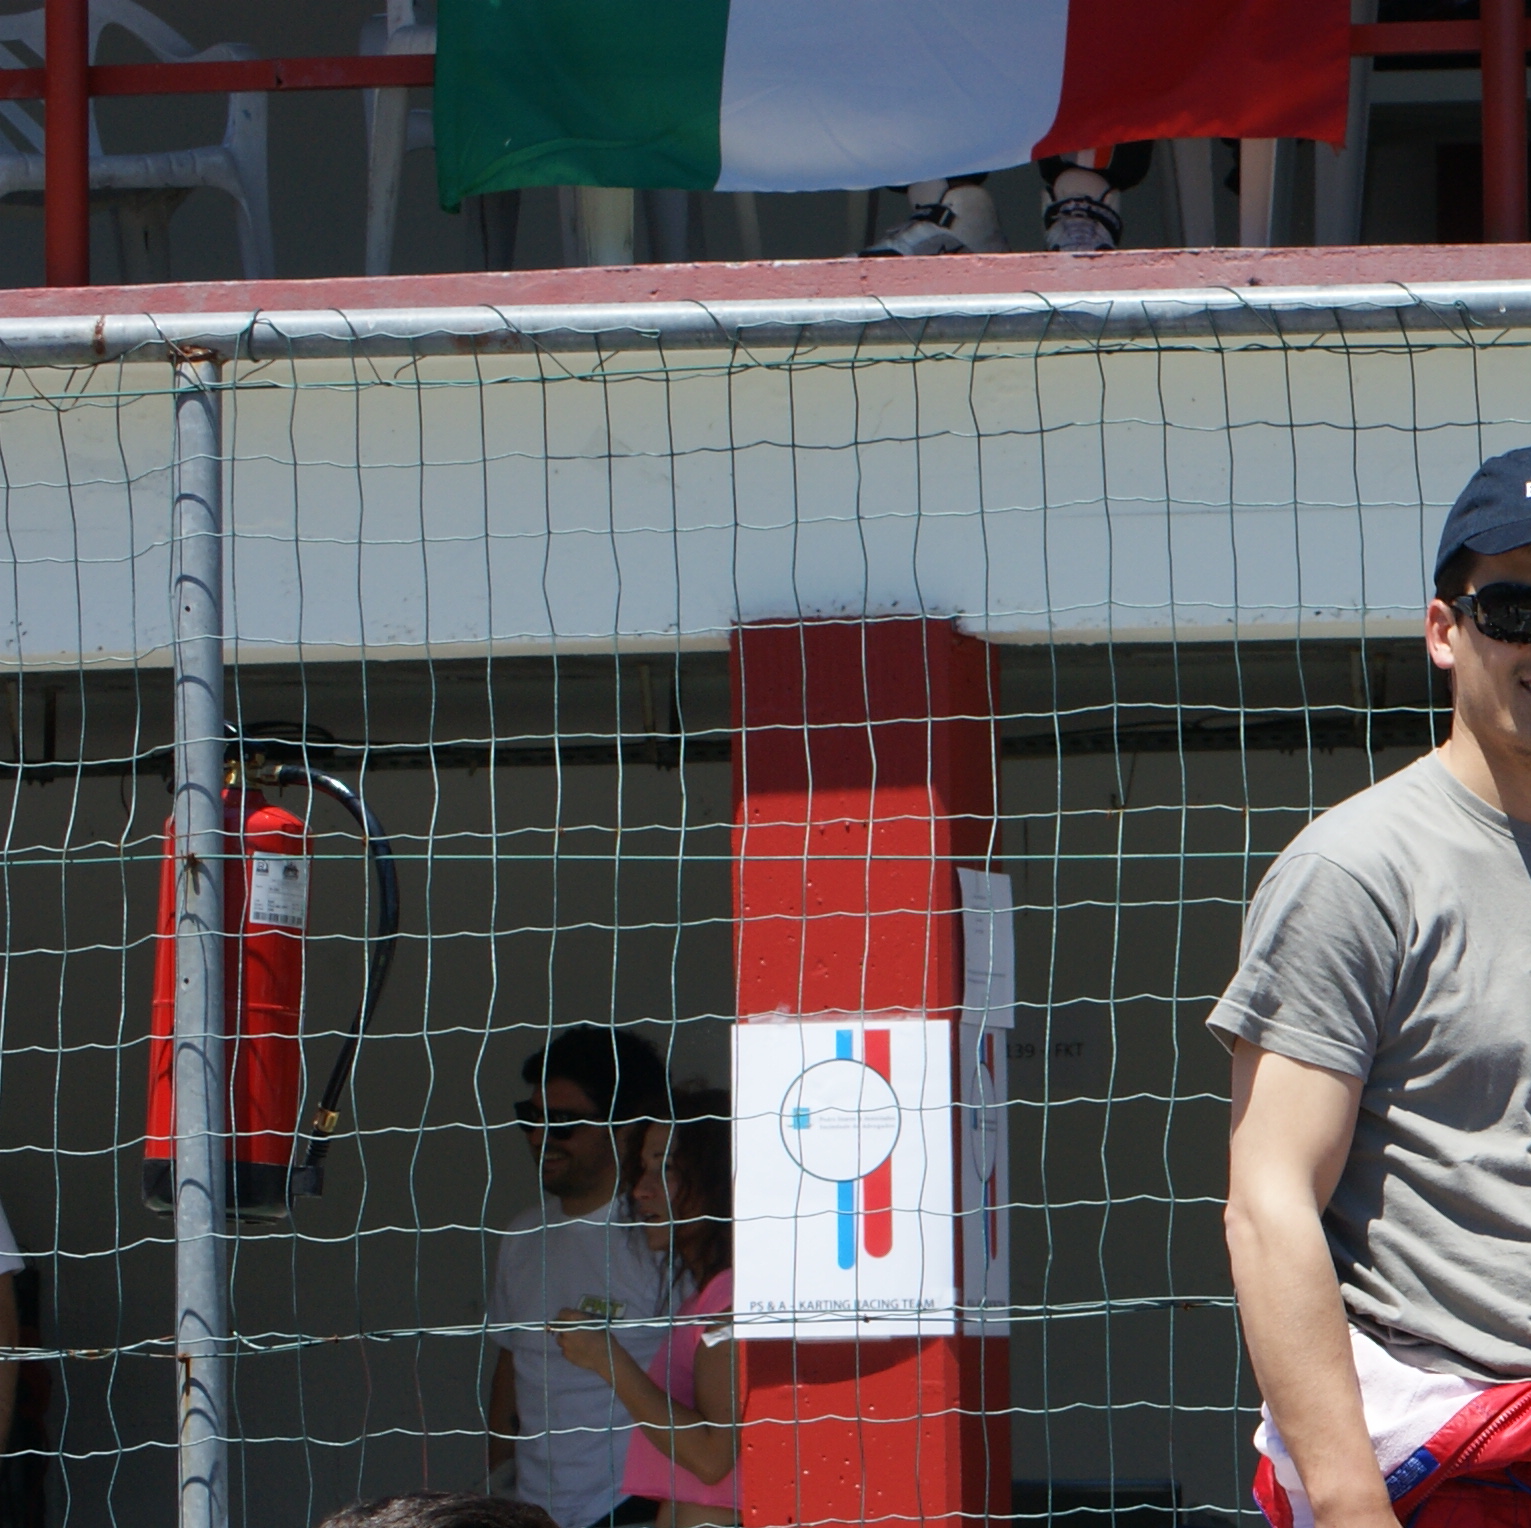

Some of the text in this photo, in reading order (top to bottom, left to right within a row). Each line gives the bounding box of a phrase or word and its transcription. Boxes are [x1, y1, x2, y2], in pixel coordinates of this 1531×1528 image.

[1055, 1043, 1084, 1058] FKT
[750, 1301, 765, 1311] PS
[767, 1301, 775, 1311] &
[776, 1301, 786, 1311] A
[800, 1300, 850, 1311] KARTING
[902, 1298, 935, 1309] TEAM
